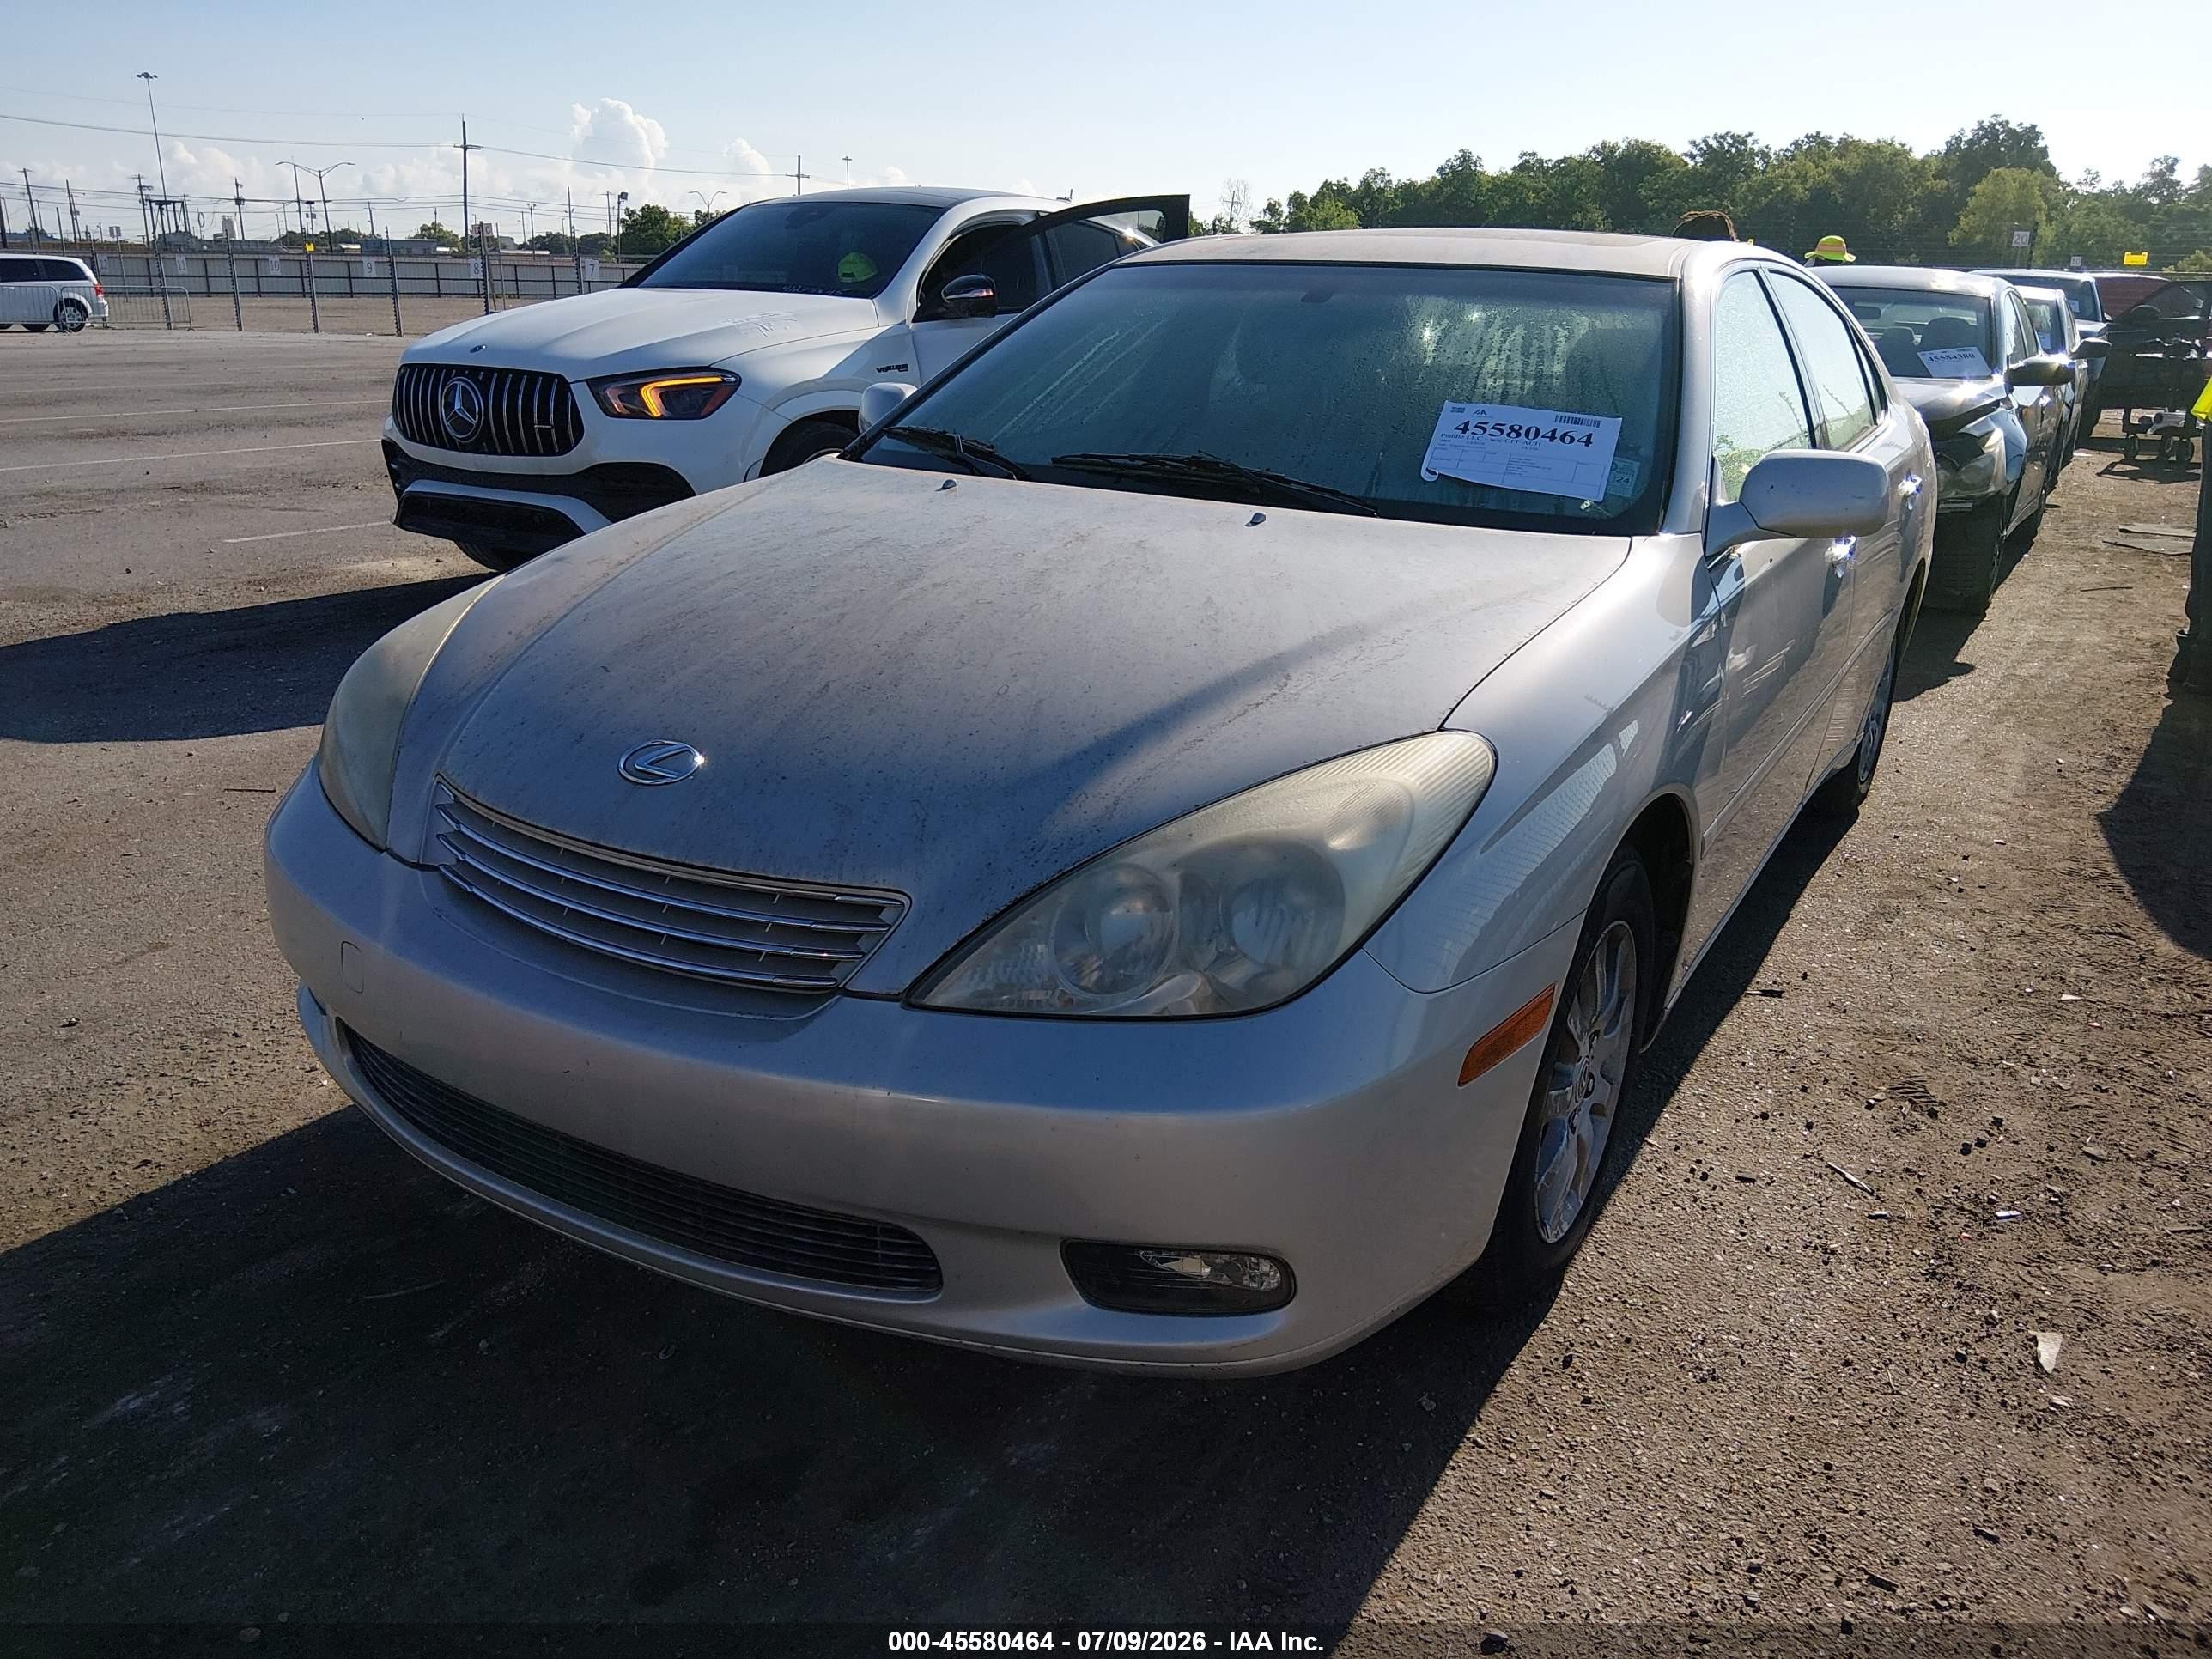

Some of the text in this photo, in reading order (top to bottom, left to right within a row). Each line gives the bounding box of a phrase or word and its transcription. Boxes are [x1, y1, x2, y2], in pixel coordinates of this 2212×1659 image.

[2014, 234, 2028, 245] 20
[270, 261, 280, 271] 10
[367, 262, 373, 274] 9
[473, 262, 480, 275] 8
[589, 264, 595, 276] 7
[1454, 420, 1593, 447] 45580464
[1616, 476, 1630, 484] 24
